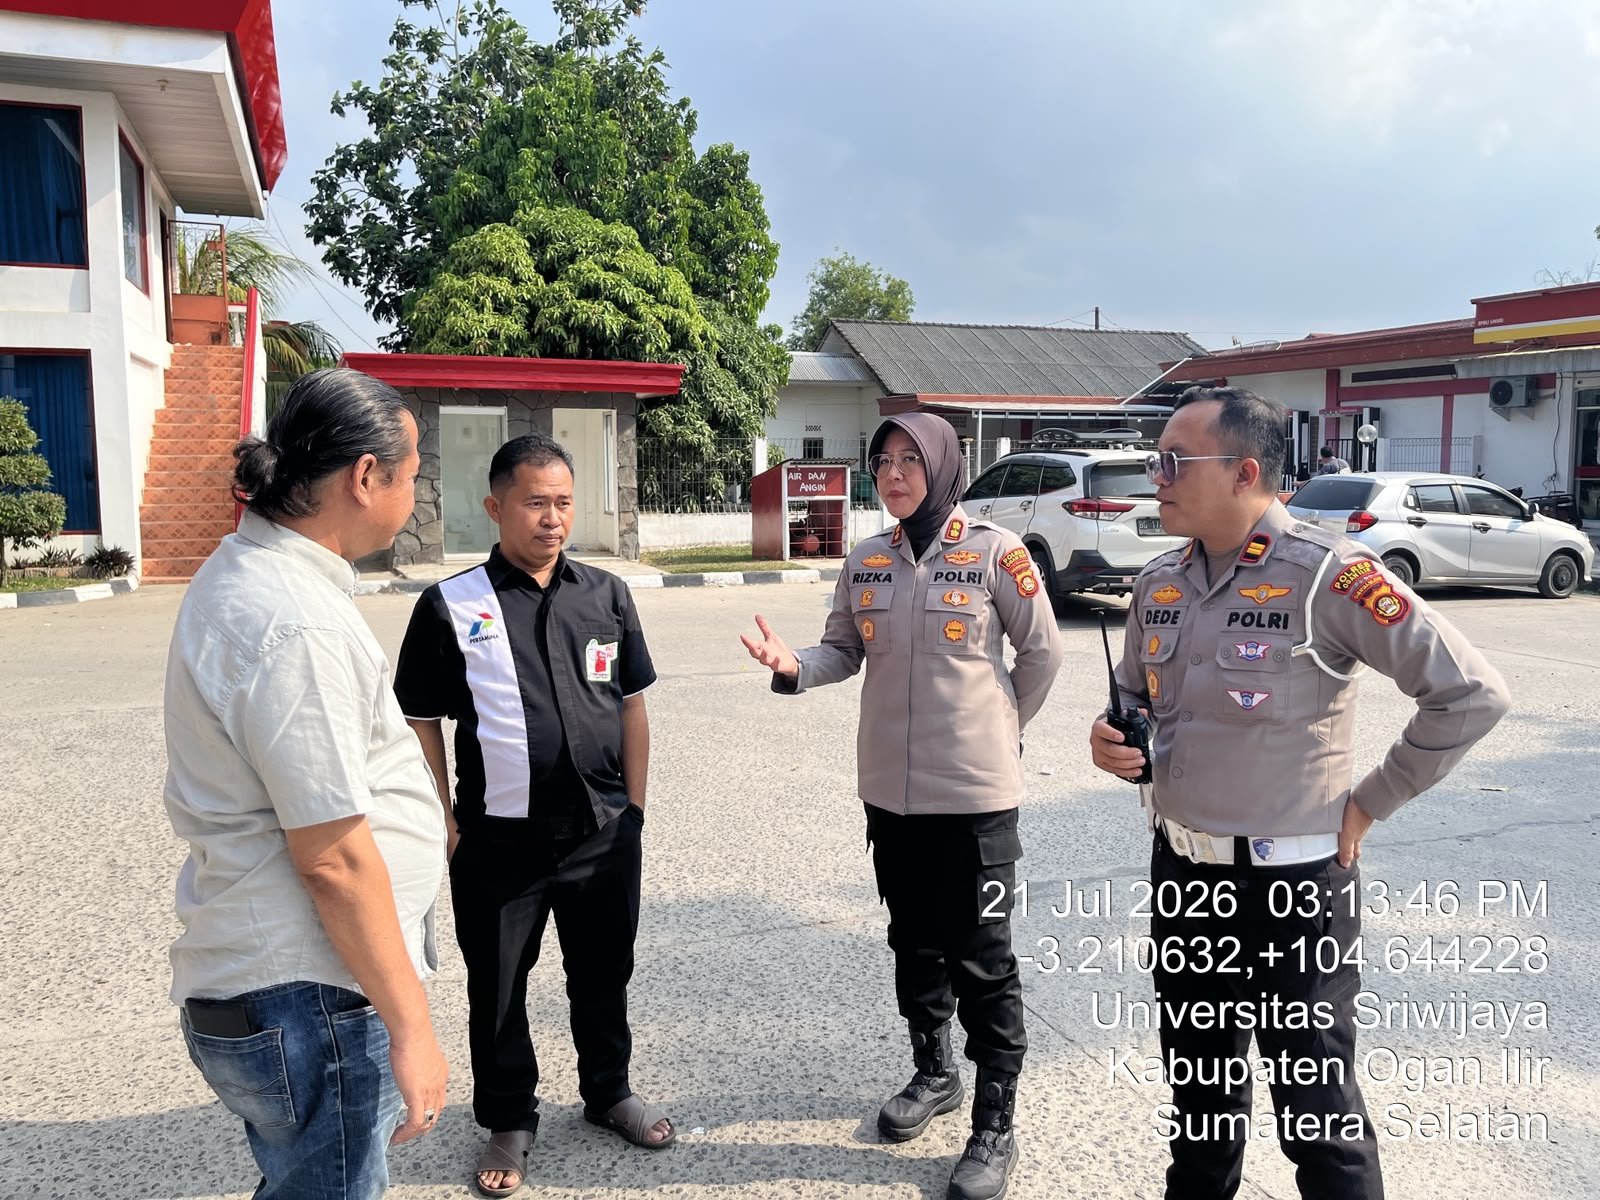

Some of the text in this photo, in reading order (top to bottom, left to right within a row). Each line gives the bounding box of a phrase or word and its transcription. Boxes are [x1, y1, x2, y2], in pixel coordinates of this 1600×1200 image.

[788, 472, 826, 480] AIR DAN
[800, 482, 826, 491] ANGIN
[852, 572, 892, 584] RIZKA
[934, 571, 982, 584] POLRI
[1334, 561, 1371, 589] POLRES
[1145, 610, 1181, 625] DEDE
[1227, 611, 1290, 630] POLRI
